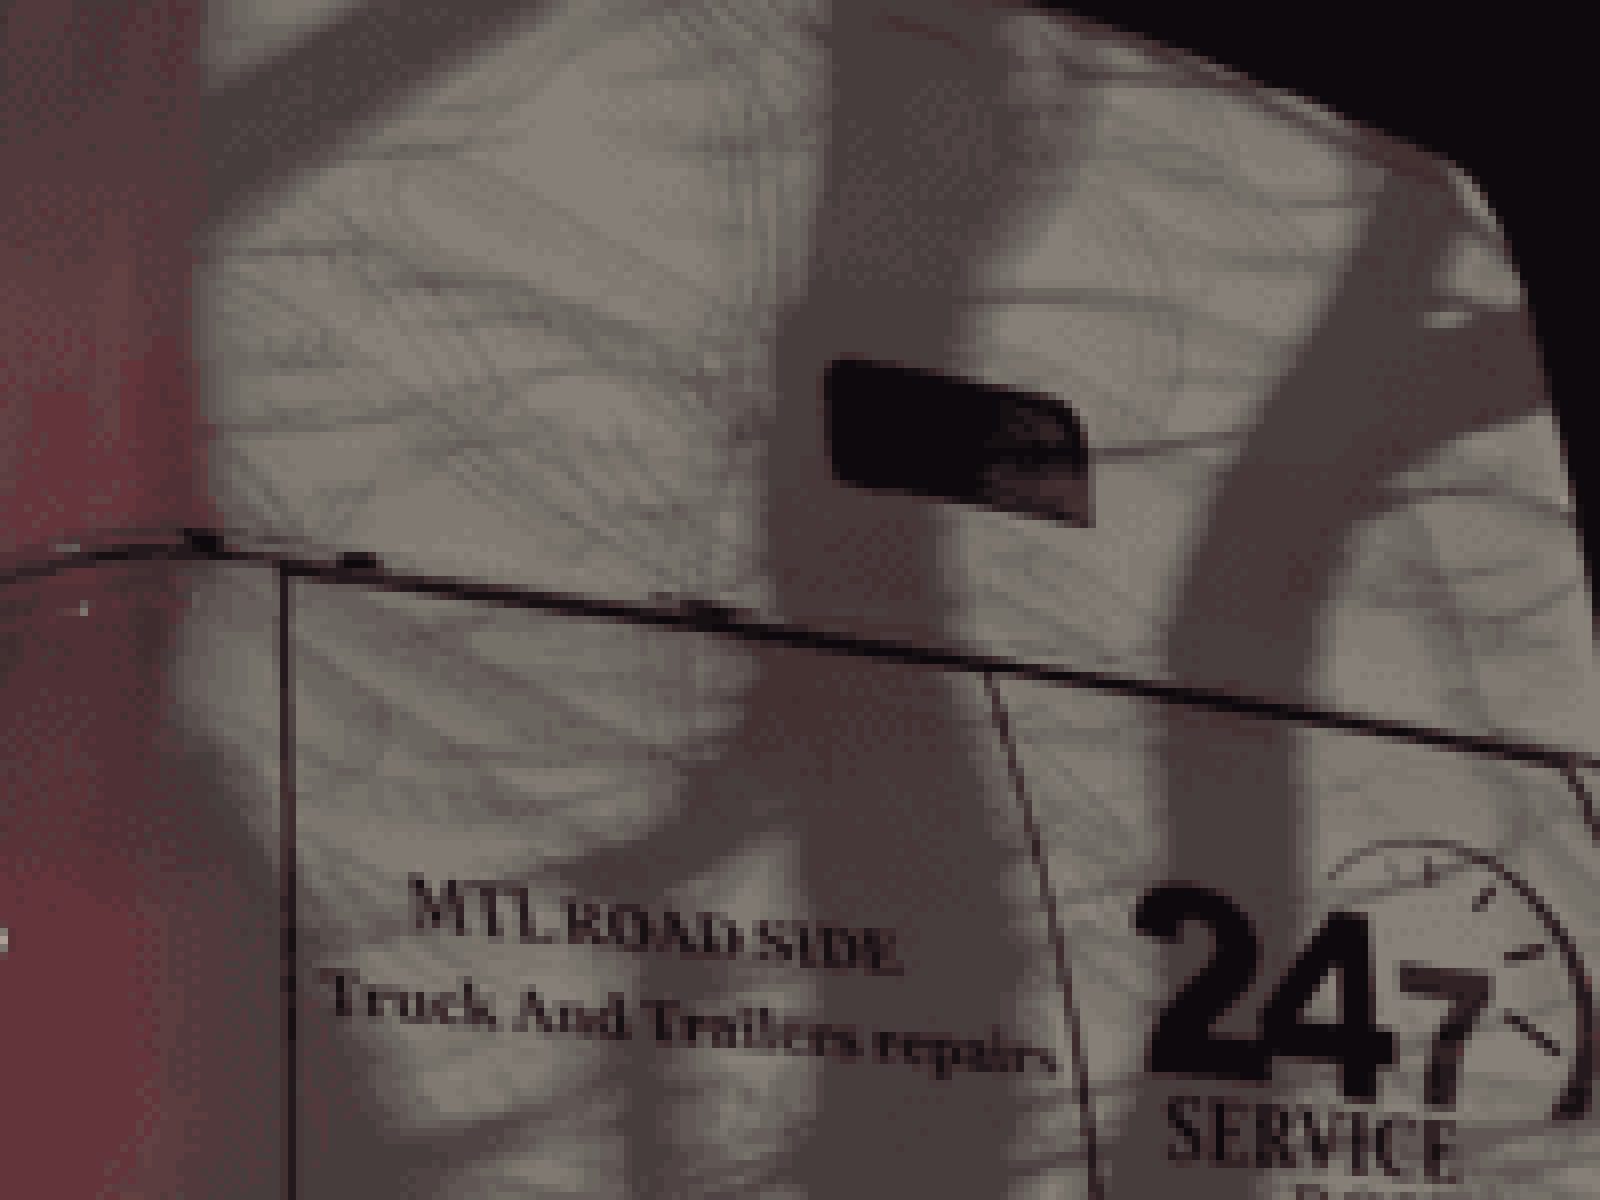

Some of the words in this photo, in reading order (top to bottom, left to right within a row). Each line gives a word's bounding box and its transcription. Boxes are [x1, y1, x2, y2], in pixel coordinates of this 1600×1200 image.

[409, 873, 550, 944] MTL
[567, 902, 742, 963] ROAD
[758, 918, 904, 976] SIDE
[318, 967, 496, 1027] Truck
[513, 986, 634, 1040] And
[640, 1000, 866, 1066] Trailers
[870, 1030, 1058, 1081] repairs
[1164, 1096, 1458, 1184] SERVICE
